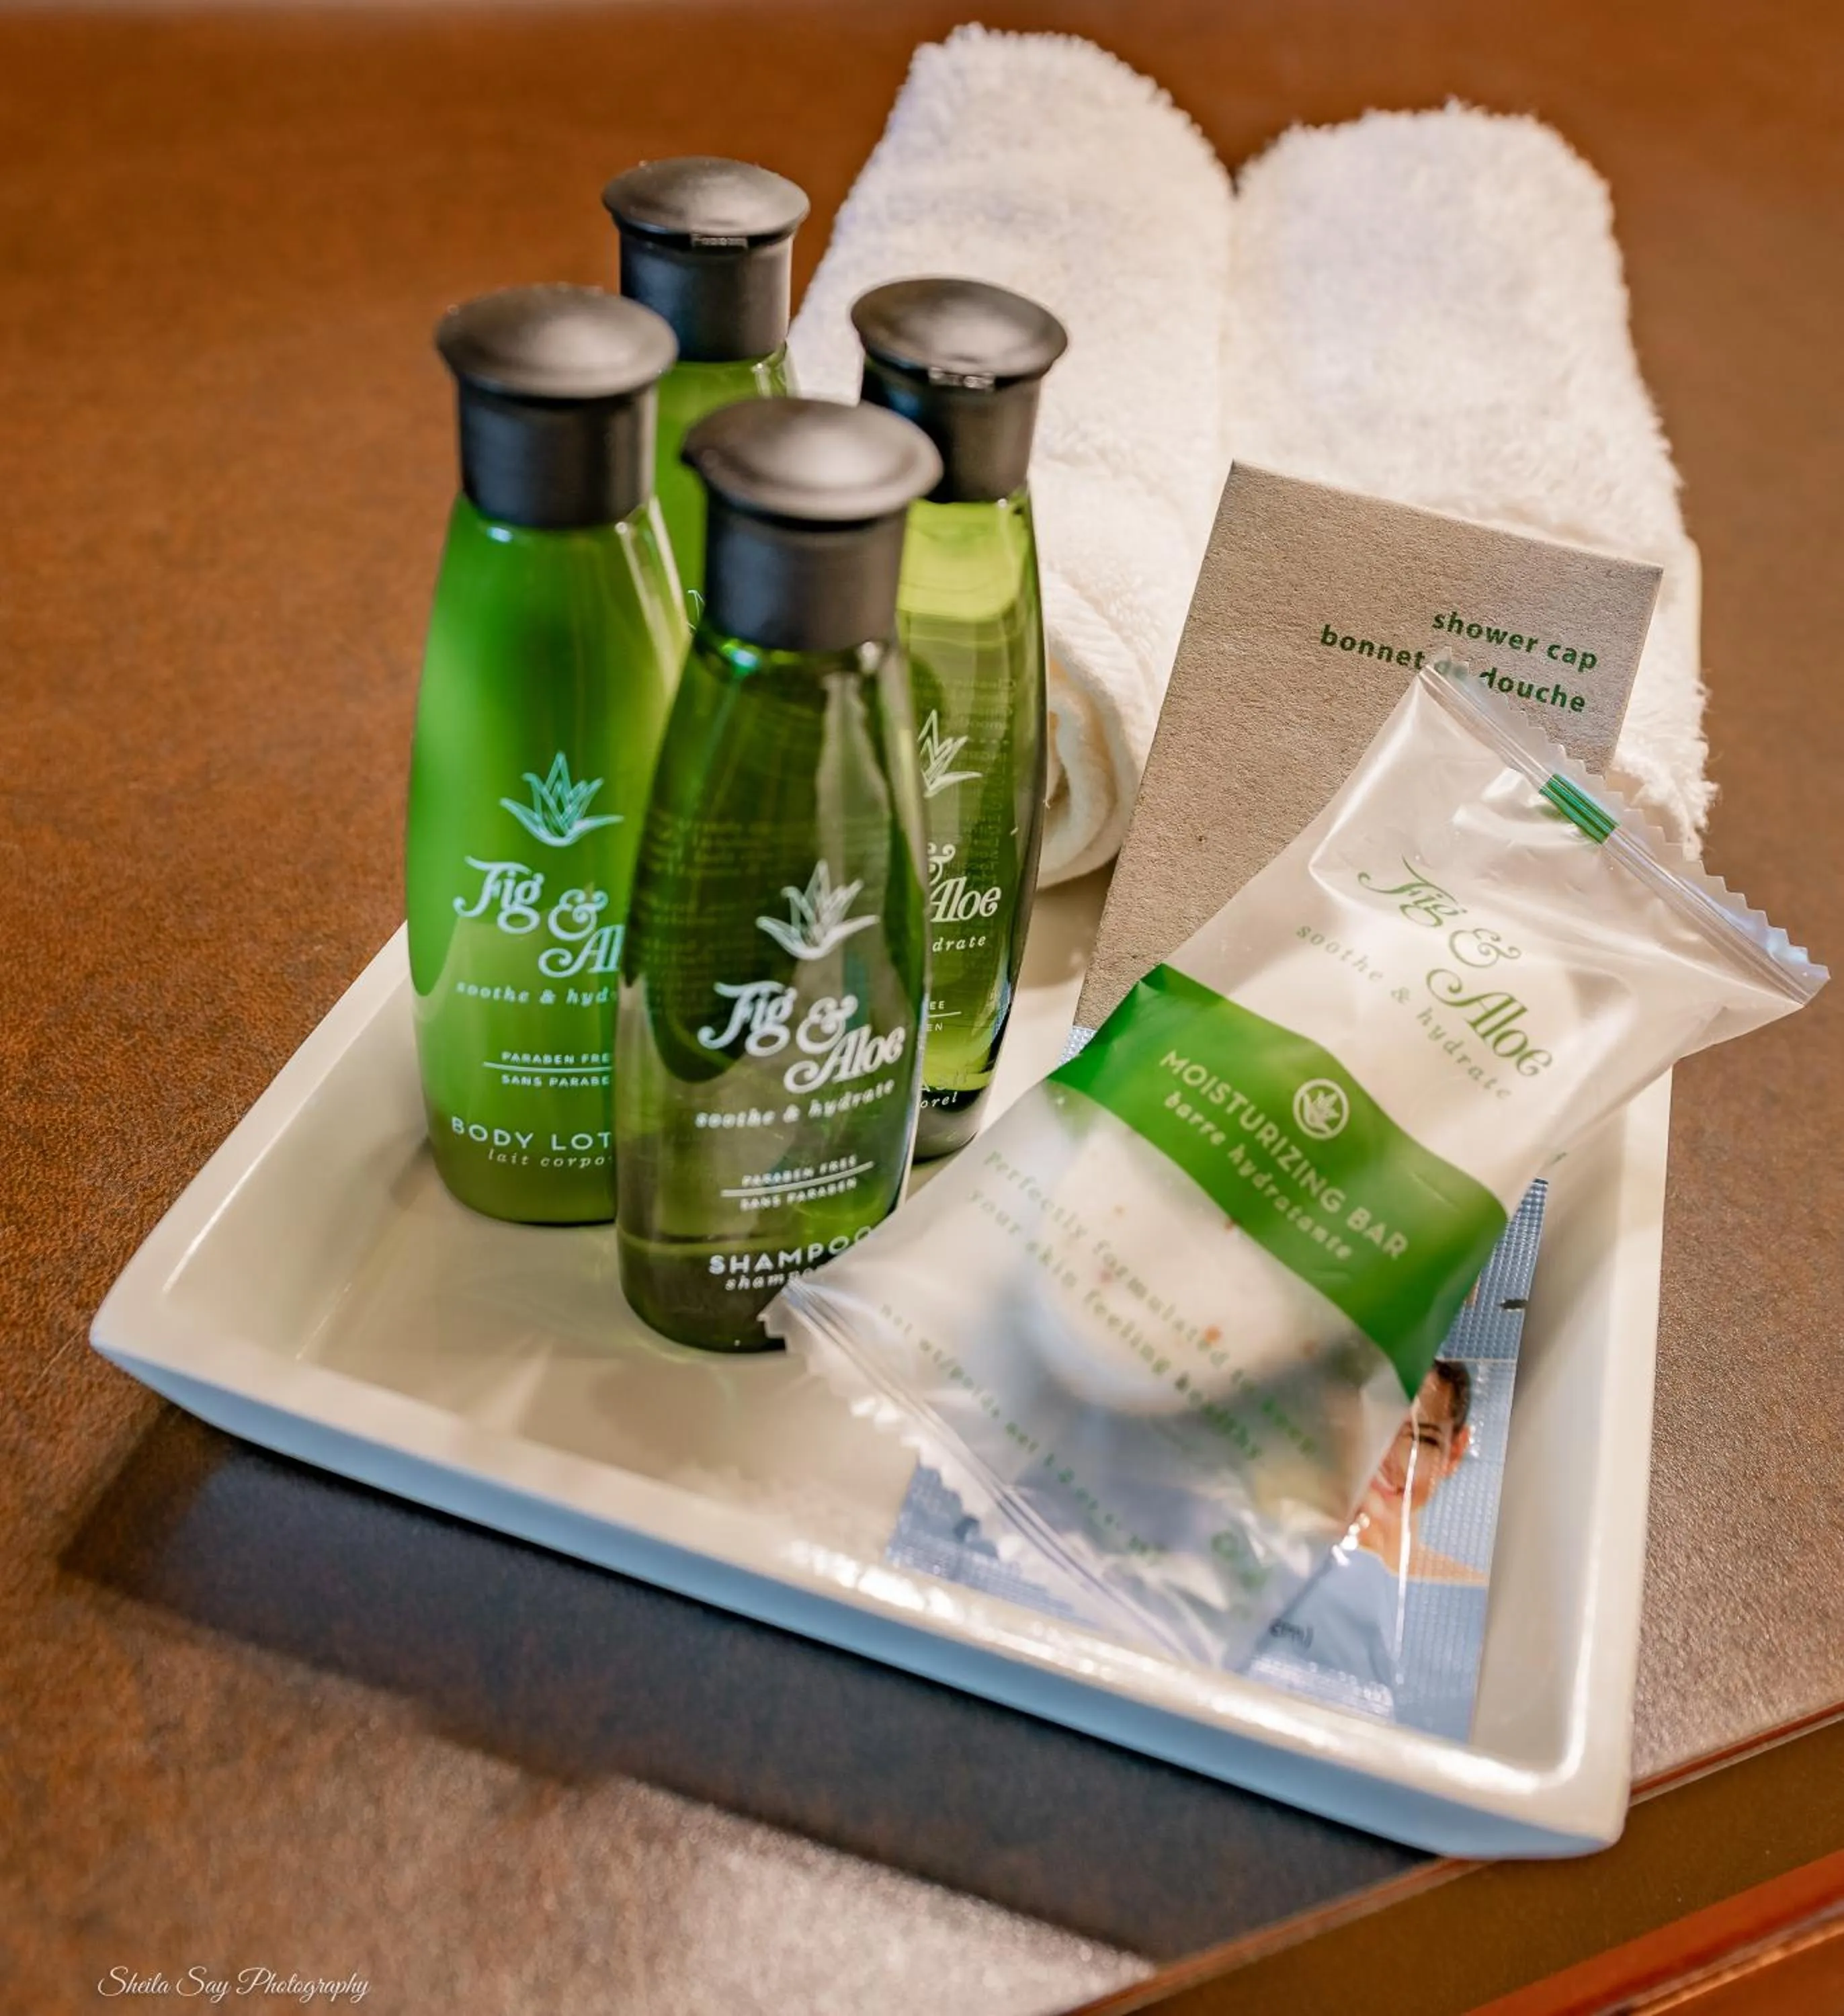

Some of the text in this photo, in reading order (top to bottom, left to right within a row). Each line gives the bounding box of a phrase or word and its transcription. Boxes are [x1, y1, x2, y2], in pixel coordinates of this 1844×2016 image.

[1321, 624, 1426, 670] bonnet
[1480, 667, 1586, 713] douche
[1432, 612, 1598, 673] shower cap
[453, 855, 608, 941] Fig &
[1357, 853, 1521, 968] Fig &
[538, 924, 626, 978] Al
[932, 935, 987, 953] drate
[456, 982, 530, 1003] soothe
[539, 989, 556, 1005] &
[698, 980, 859, 1058] Fig &
[1296, 925, 1513, 1101] soothe & hydrate
[1425, 968, 1553, 1077] Aloe
[501, 1051, 612, 1065] PARABEN FRE
[501, 1074, 611, 1088] SANS PARABE
[784, 1023, 907, 1095] Aloe
[694, 1107, 776, 1129] soothe
[808, 1079, 896, 1120] hydrate
[920, 1091, 958, 1108] orel
[451, 1116, 612, 1151] BODY LOT
[488, 1148, 607, 1169] lait corpo
[1159, 1049, 1409, 1261] MOISTURIZING BAR
[1164, 1090, 1353, 1261] barre hydratante
